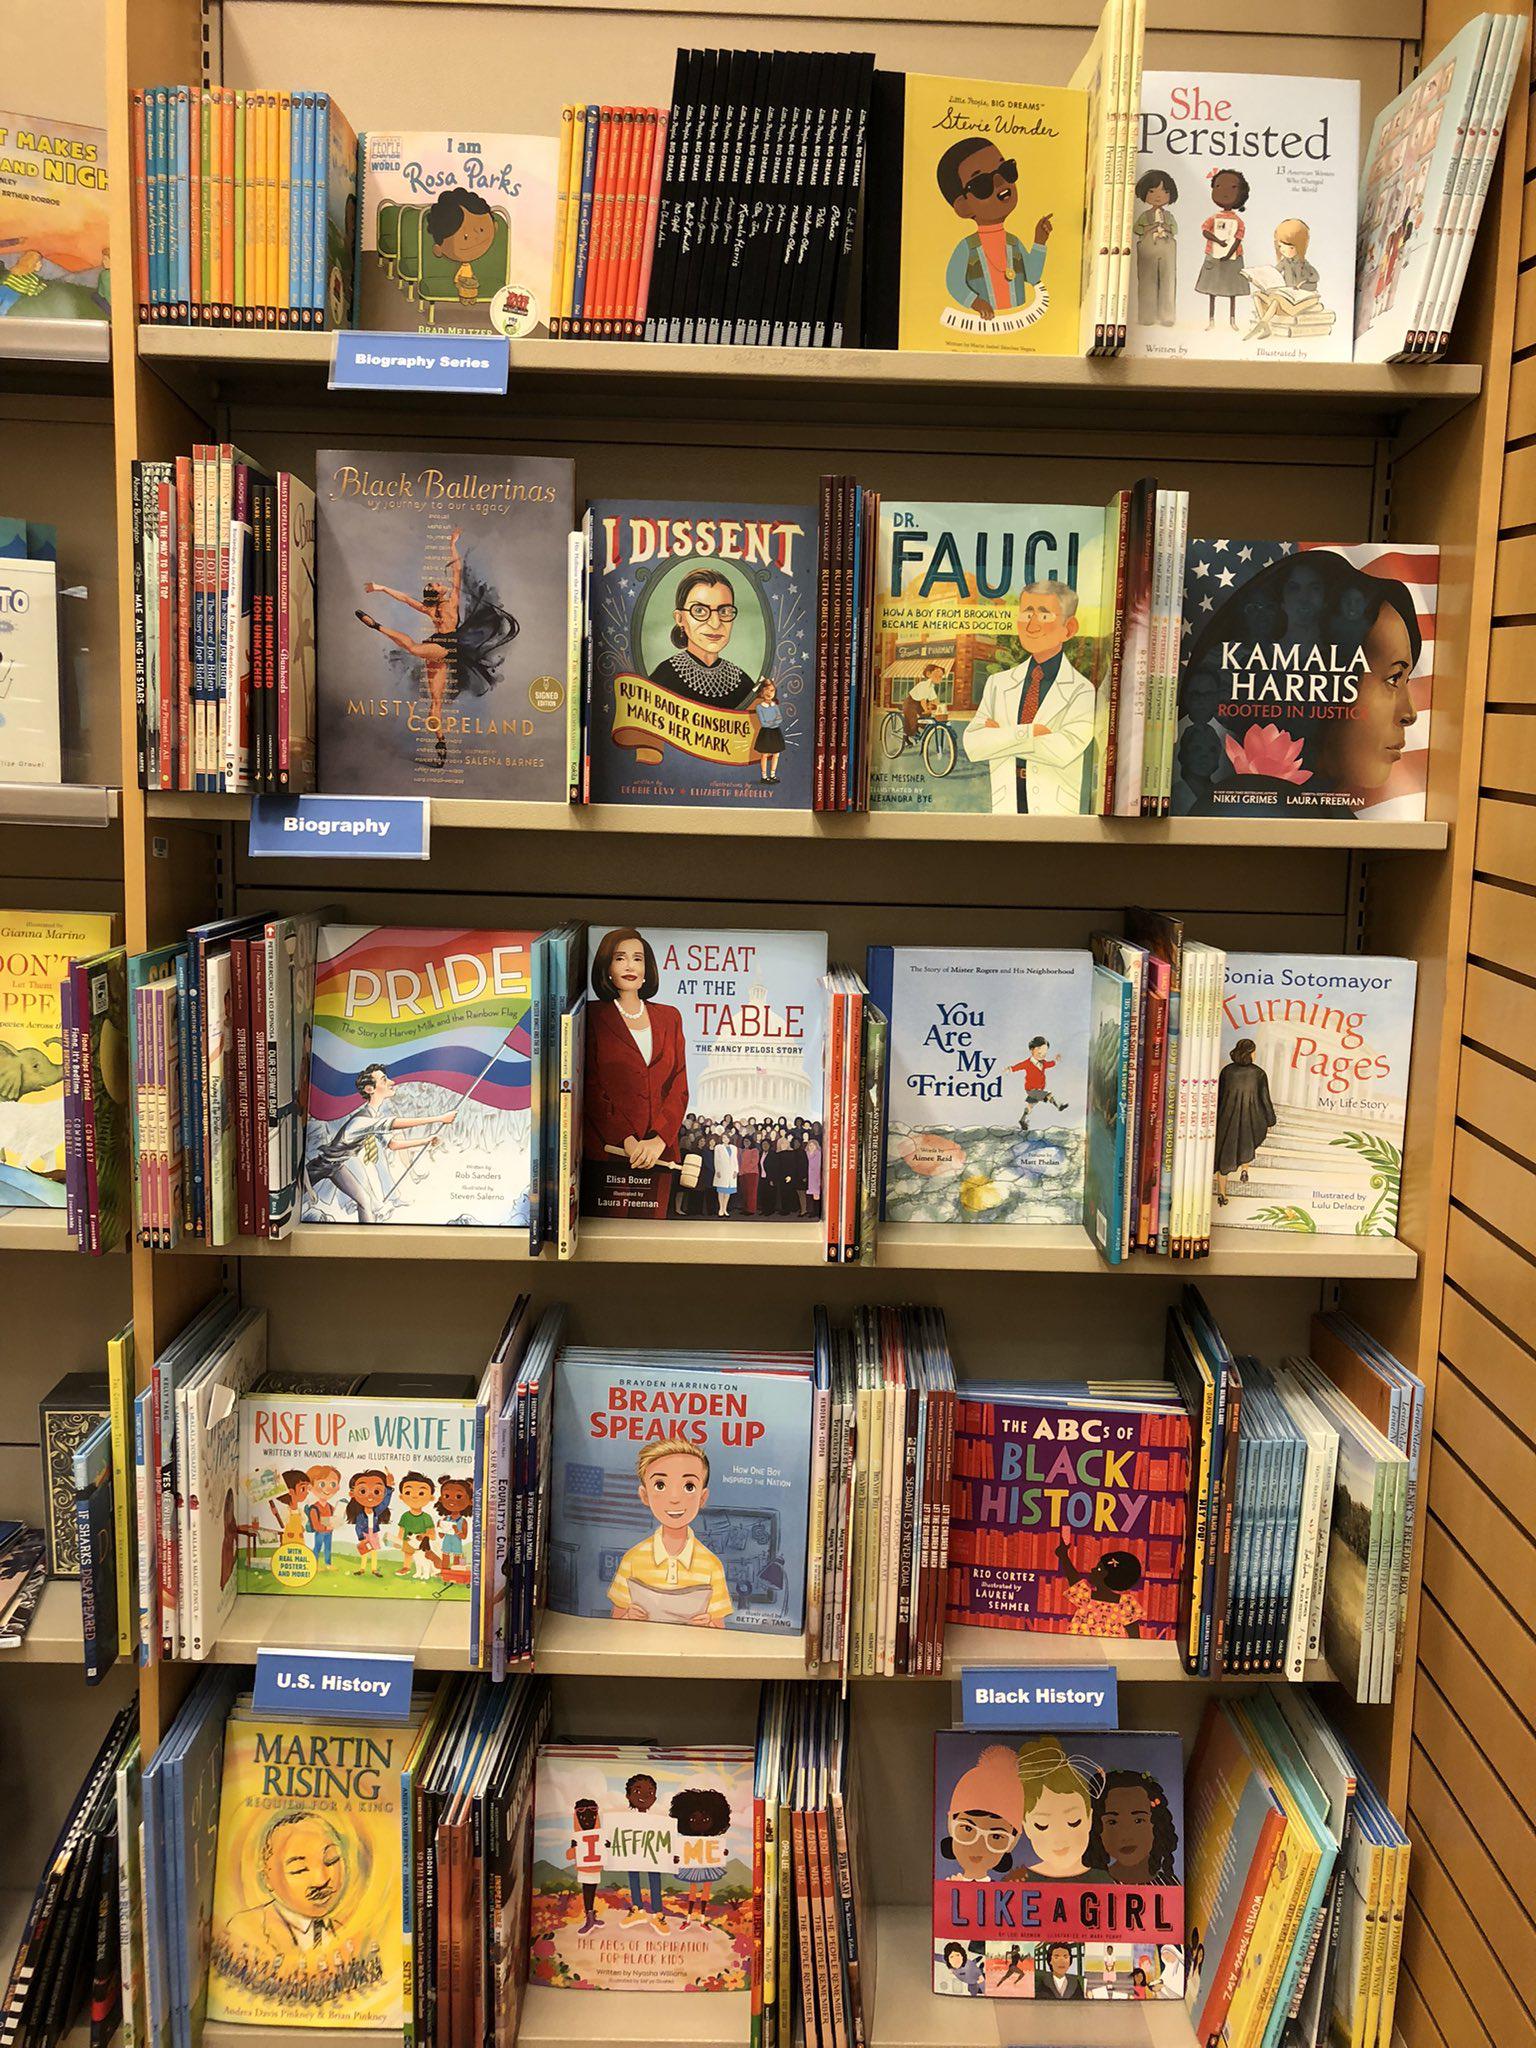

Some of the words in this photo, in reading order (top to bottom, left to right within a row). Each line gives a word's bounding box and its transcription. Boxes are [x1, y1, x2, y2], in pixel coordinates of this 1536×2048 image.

[991, 100, 1005, 108] BIG
[1007, 101, 1041, 110] DREAMS
[1170, 86, 1232, 122] She
[932, 107, 991, 132] Stevie
[993, 115, 1060, 138] Wonder
[16, 131, 97, 162] MAKES
[447, 138, 453, 153] I
[457, 141, 482, 154] am
[1137, 112, 1333, 162] Persisted
[0, 158, 39, 177] AND
[43, 159, 109, 191] NIGH
[403, 162, 458, 195] Rosa
[463, 157, 522, 197] Parks
[829, 205, 840, 241] Prince
[732, 239, 744, 268] Harris
[355, 353, 436, 369] Biography
[440, 356, 490, 369] Series
[329, 466, 413, 501] Black
[417, 469, 557, 503] Ballerinas
[893, 512, 919, 529] DR.
[602, 517, 622, 576] I
[627, 517, 805, 577] DISSENT
[890, 530, 1080, 600] FAUCI
[881, 620, 920, 630] BECAME
[923, 620, 970, 630] AMERICA'S
[972, 620, 1013, 631] DOCTOR
[883, 608, 904, 618] HOW
[906, 608, 913, 618] A
[915, 608, 934, 618] BOY
[936, 608, 961, 618] FROM
[964, 609, 1011, 619] BROOKLYN
[266, 624, 274, 689] UNMATCHED
[1220, 641, 1372, 673] KAMALA
[535, 691, 559, 700] SIGNED
[1231, 673, 1359, 703] HARRIS
[347, 699, 417, 717] MISTY
[619, 682, 652, 704] RUTH
[654, 694, 689, 724] BADER
[692, 712, 751, 736] GINSBURG
[1218, 703, 1283, 718] ROOTED
[1287, 704, 1305, 719] IN
[407, 715, 535, 737] COPELAND
[626, 703, 666, 731] MAKES
[668, 722, 693, 746] HER
[695, 731, 731, 755] MARK
[465, 756, 502, 767] SALENA
[505, 757, 545, 768] BARNES
[1213, 794, 1241, 804] NIKKI
[1242, 794, 1278, 805] GRIMES
[1286, 795, 1317, 806] LAURA
[1319, 796, 1365, 807] FREEMAN
[283, 817, 391, 836] Biography
[1, 927, 42, 939] Gianna
[46, 929, 86, 941] Marino
[663, 944, 680, 970] A
[687, 945, 756, 973] SEAT
[924, 966, 941, 975] Story
[976, 967, 999, 976] Rogers
[1026, 968, 1075, 976] Neighborhood
[344, 945, 527, 1019] PRIDE
[677, 979, 699, 995] AT
[703, 980, 736, 996] THE
[1225, 967, 1274, 985] Sonia
[1282, 969, 1392, 993] Sotomayor
[341, 1023, 355, 1034] The
[357, 1027, 378, 1040] Story
[379, 1029, 388, 1038] of
[388, 1027, 416, 1039] Harvey
[417, 1020, 435, 1033] Milk
[436, 1015, 450, 1026] and
[452, 1012, 464, 1022] the
[466, 1009, 500, 1020] Rainbow
[501, 1007, 518, 1020] Flag
[695, 1003, 804, 1038] TABLE
[936, 1002, 986, 1027] You
[1222, 993, 1368, 1050] Turning
[696, 1045, 712, 1053] THE
[715, 1045, 742, 1054] NANCY
[744, 1046, 774, 1054] PELOSI
[777, 1046, 803, 1055] STORY
[923, 1025, 972, 1053] Are
[269, 1049, 277, 1063] OUR
[956, 1050, 997, 1078] My
[1290, 1037, 1391, 1094] Pages
[269, 1065, 278, 1096] SUBWAY
[907, 1074, 1003, 1102] Friend
[270, 1098, 278, 1118] BABY
[1318, 1097, 1337, 1109] My
[1339, 1098, 1357, 1109] Life
[1359, 1099, 1389, 1111] Story
[606, 1174, 626, 1184] Elisa
[628, 1176, 652, 1185] Boxer
[597, 1198, 620, 1207] Laura
[623, 1199, 659, 1209] Freeman
[1311, 1201, 1331, 1210] Lulu
[1332, 1202, 1365, 1211] Delacre
[1312, 1190, 1355, 1201] Illustrated
[1357, 1192, 1367, 1202] by
[619, 1379, 666, 1388] BRAYDEN
[671, 1381, 739, 1391] HARRINGTON
[608, 1387, 748, 1418] BRAYDEN
[254, 1410, 308, 1446] RISE
[315, 1413, 347, 1447] UP
[348, 1427, 370, 1441] AND
[374, 1415, 457, 1451] WRITE
[590, 1411, 709, 1446] SPEAKS
[722, 1421, 766, 1447] UP
[1002, 1419, 1028, 1434] THE
[1032, 1417, 1110, 1443] ABCs
[1117, 1426, 1134, 1441] OF
[750, 1467, 765, 1476] ONE
[766, 1467, 781, 1476] BOY
[1001, 1443, 1135, 1489] BLACK
[722, 1476, 752, 1485] INSPIRED
[766, 1478, 791, 1487] NATION
[79, 1510, 90, 1519] IF
[497, 1478, 509, 1531] EQUALITY'S
[980, 1484, 1149, 1533] HISTORY
[1405, 1479, 1417, 1522] HENRY'S
[80, 1523, 92, 1565] SHARKS
[497, 1536, 507, 1561] CALL
[1401, 1525, 1413, 1573] FREEDOM
[972, 1568, 993, 1580] RIO
[995, 1570, 1035, 1583] CORTEZ
[1399, 1575, 1409, 1595] BOX
[82, 1568, 96, 1641] DISAPPEARED
[975, 1588, 1015, 1600] LAUREN
[988, 1601, 1030, 1613] SEMMER
[277, 1673, 315, 1690] U.S.
[322, 1676, 391, 1696] History
[975, 1688, 1031, 1705] Black
[1035, 1689, 1105, 1707] History
[253, 1732, 394, 1769] MARTIN
[262, 1765, 381, 1801] RISING
[582, 1834, 601, 1863] I
[611, 1827, 672, 1864] AFFIRM
[683, 1839, 721, 1866] ME
[951, 1888, 1042, 1928] LIKE
[1052, 1897, 1067, 1923] A
[1080, 1892, 1173, 1932] GIRL
[1244, 1895, 1263, 1934] WOMEN
[403, 1961, 411, 1996] SIT-IN
